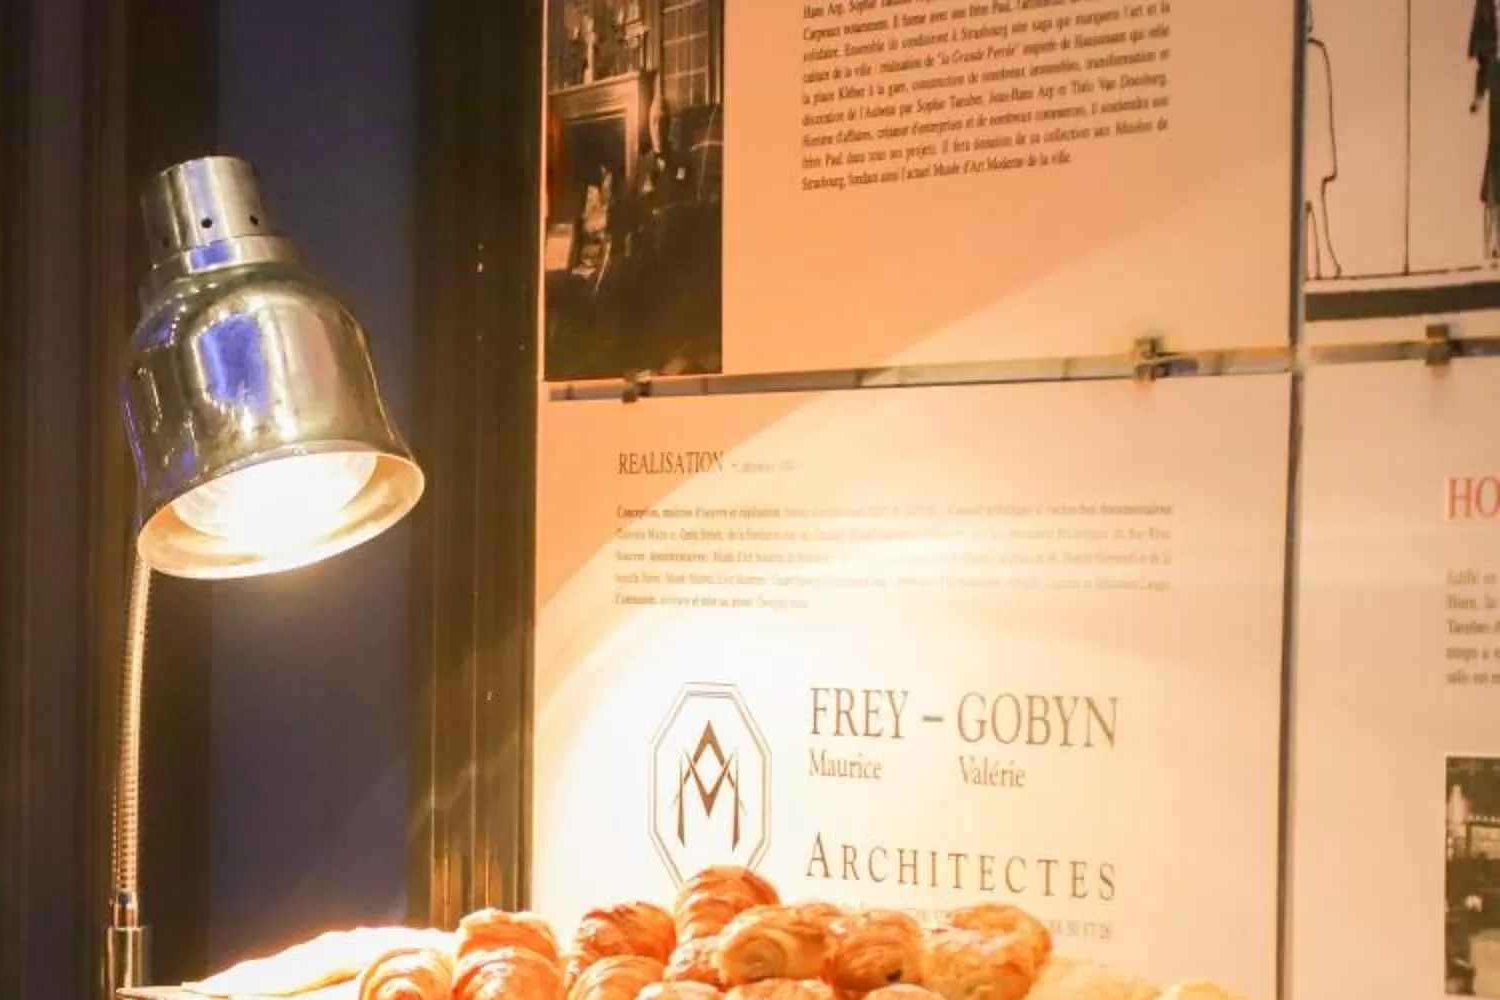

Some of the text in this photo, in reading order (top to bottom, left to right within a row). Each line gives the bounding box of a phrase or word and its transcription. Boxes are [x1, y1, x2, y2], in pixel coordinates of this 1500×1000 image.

[810, 687, 910, 739] FREY
[957, 692, 1118, 748] GOBYN
[808, 748, 1026, 788] Maurice Valérie
